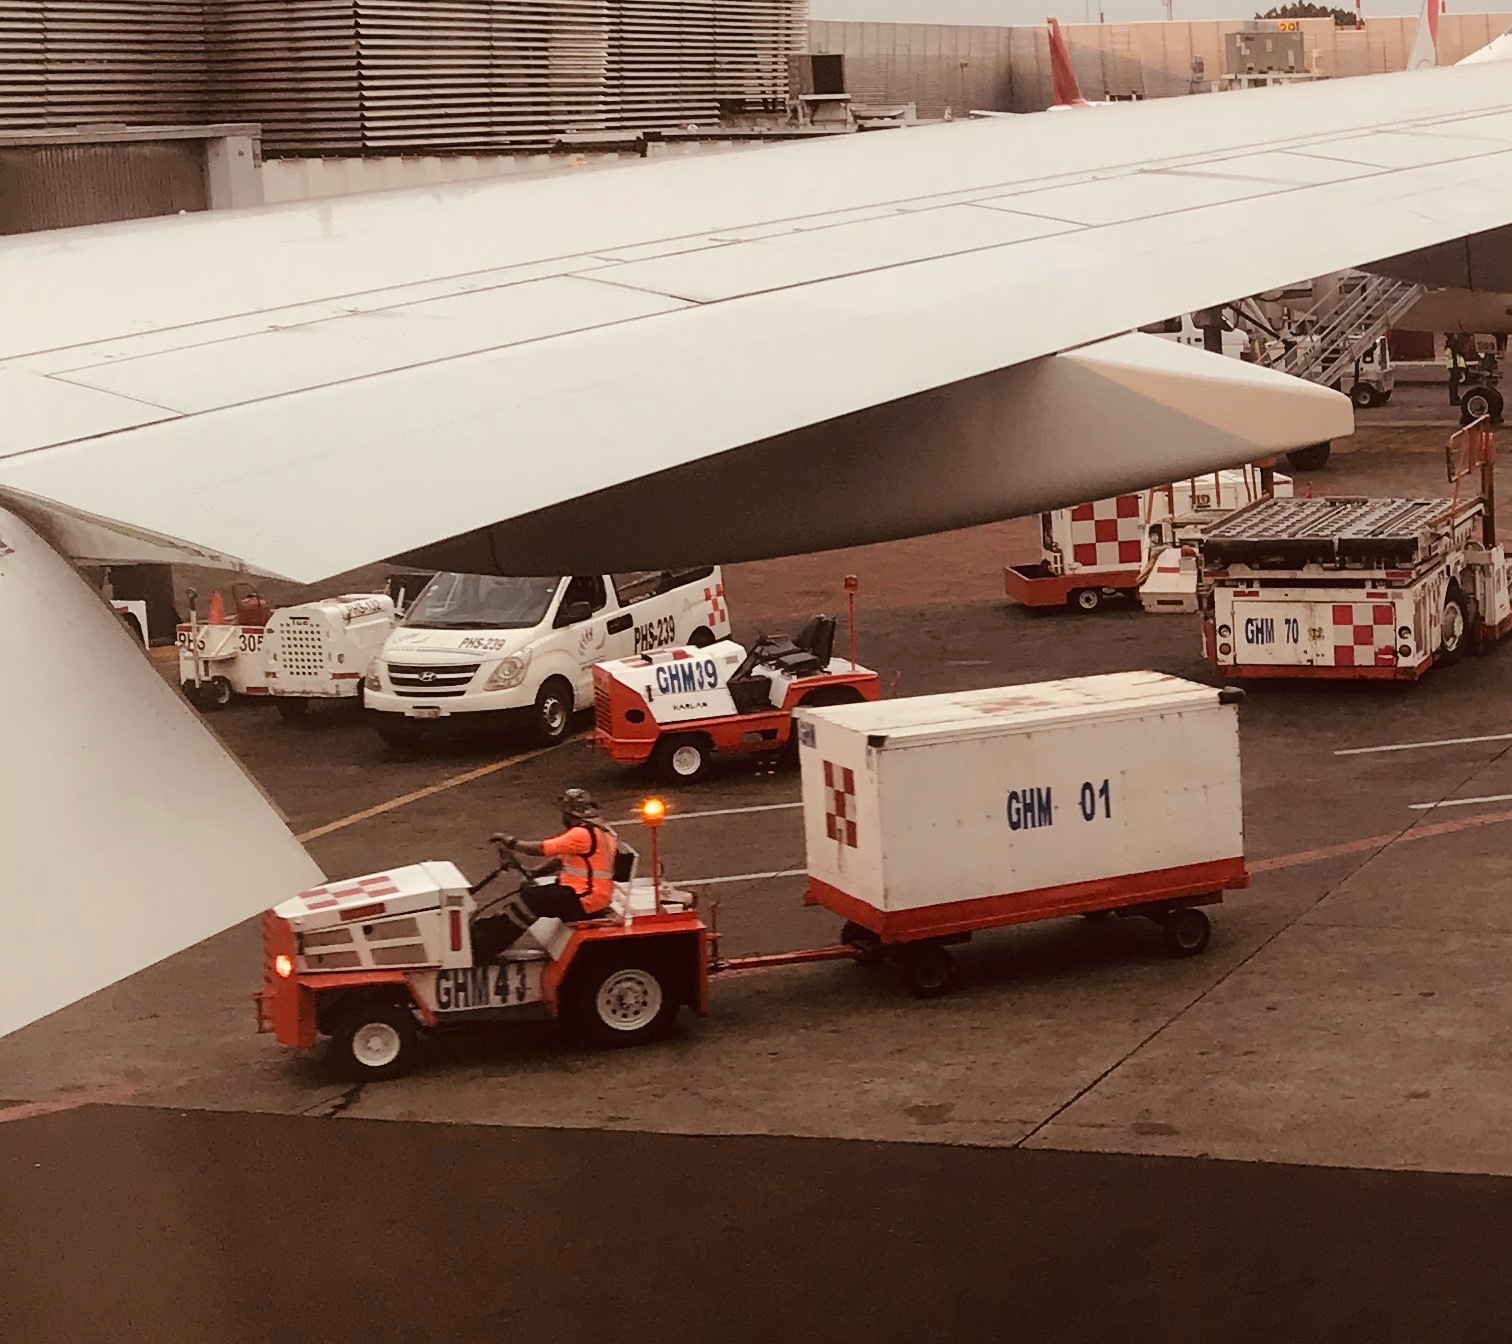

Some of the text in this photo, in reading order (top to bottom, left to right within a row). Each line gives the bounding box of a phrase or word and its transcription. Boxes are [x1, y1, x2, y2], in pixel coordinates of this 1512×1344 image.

[457, 636, 506, 651] PHS-239
[633, 614, 676, 655] PHS-239
[1245, 617, 1299, 645] GHM 70
[1007, 778, 1112, 830] GHM 01
